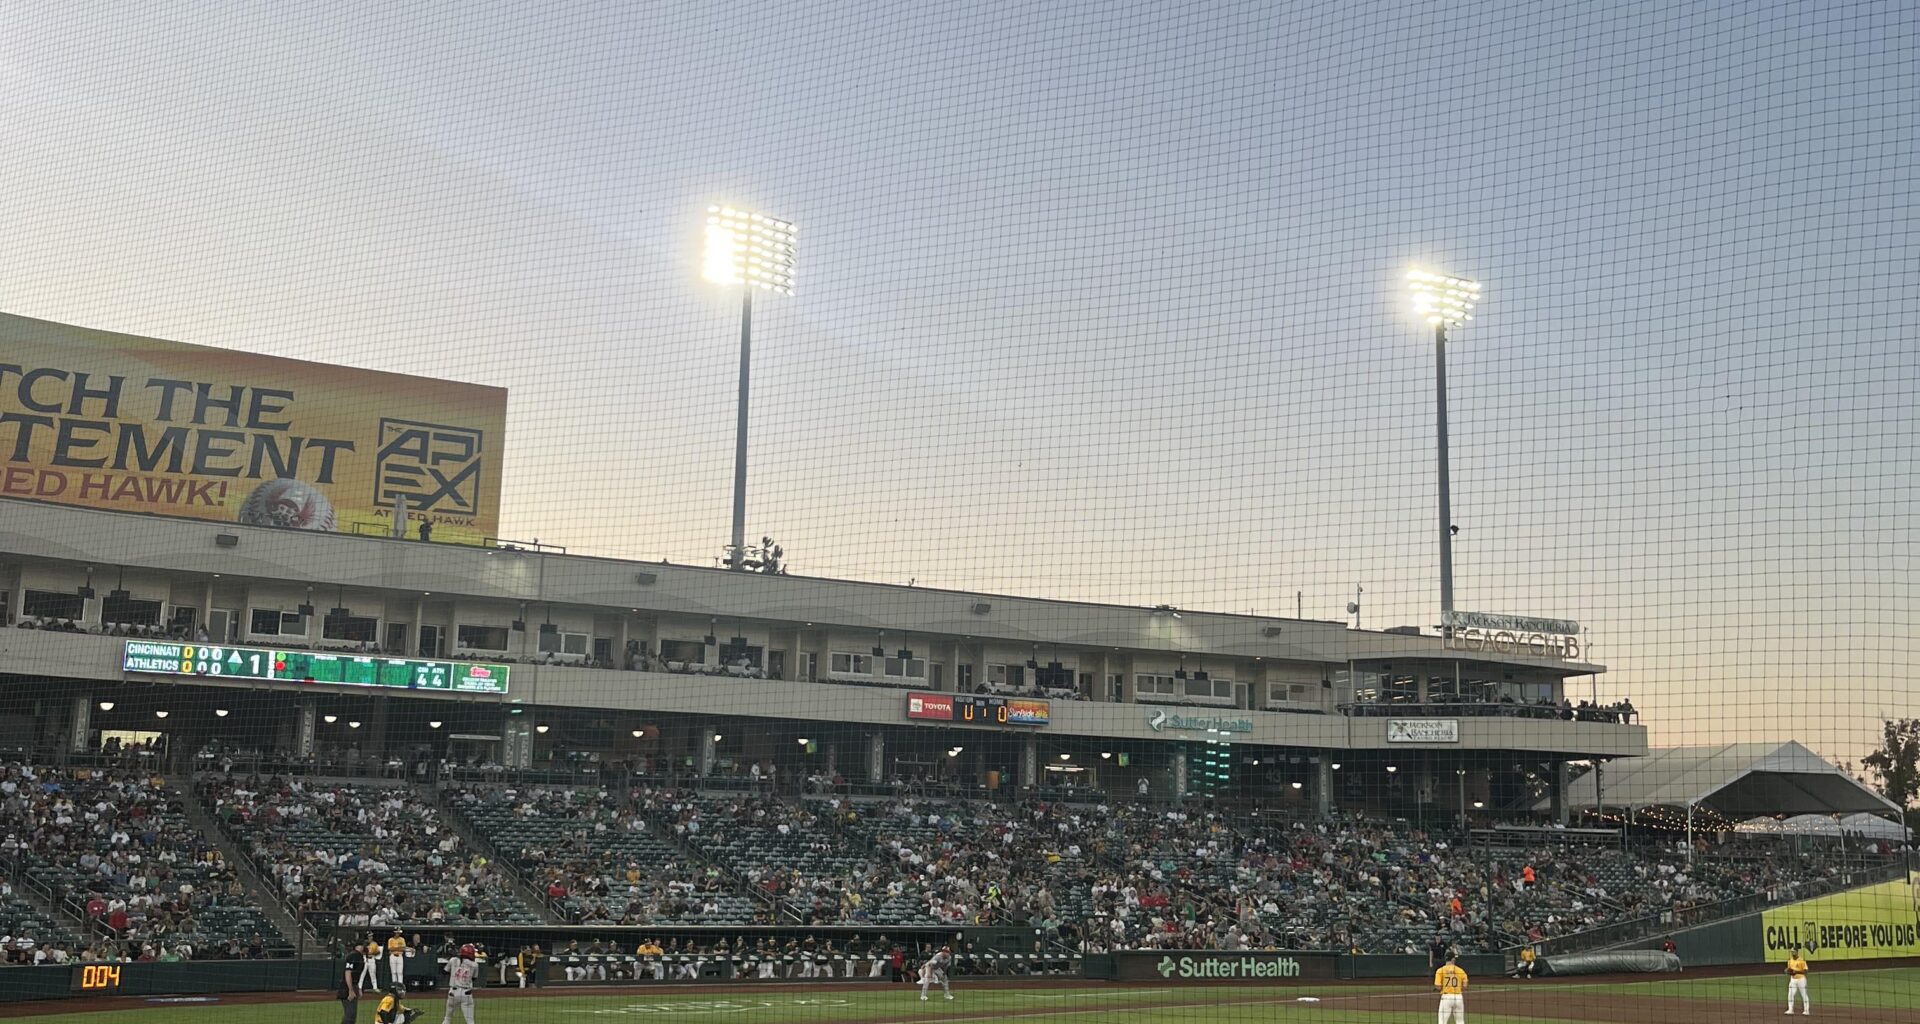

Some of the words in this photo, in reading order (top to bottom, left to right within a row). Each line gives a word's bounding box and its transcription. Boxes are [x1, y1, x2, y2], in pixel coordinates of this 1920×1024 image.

[145, 378, 295, 431] THE
[0, 411, 356, 484] TEMENT
[79, 473, 228, 507] HAWK!
[374, 509, 393, 518] AT
[432, 515, 475, 527] HAWK
[1464, 614, 1513, 627] JACKSON
[127, 643, 180, 657] CINCINNATI
[184, 646, 194, 659] 0
[198, 648, 209, 660] 0
[211, 648, 223, 661] 0
[126, 656, 179, 671] ATHLETICS
[182, 660, 193, 673] 0
[197, 661, 208, 673] 0
[210, 662, 222, 675] 0
[249, 654, 261, 675] 1
[924, 702, 952, 712] TOYOTA
[997, 705, 1008, 723] 0
[1171, 714, 1210, 730] Sutter
[1213, 716, 1253, 732] Health
[1767, 925, 1802, 950] CALL
[1820, 925, 1868, 949] BEFORE
[1869, 924, 1893, 947] YOU
[1895, 924, 1915, 946] DIG
[454, 968, 471, 982] 44
[1179, 956, 1239, 978] Sutter
[1241, 956, 1300, 977] Health
[82, 965, 121, 988] 004
[1444, 976, 1459, 988] 70
